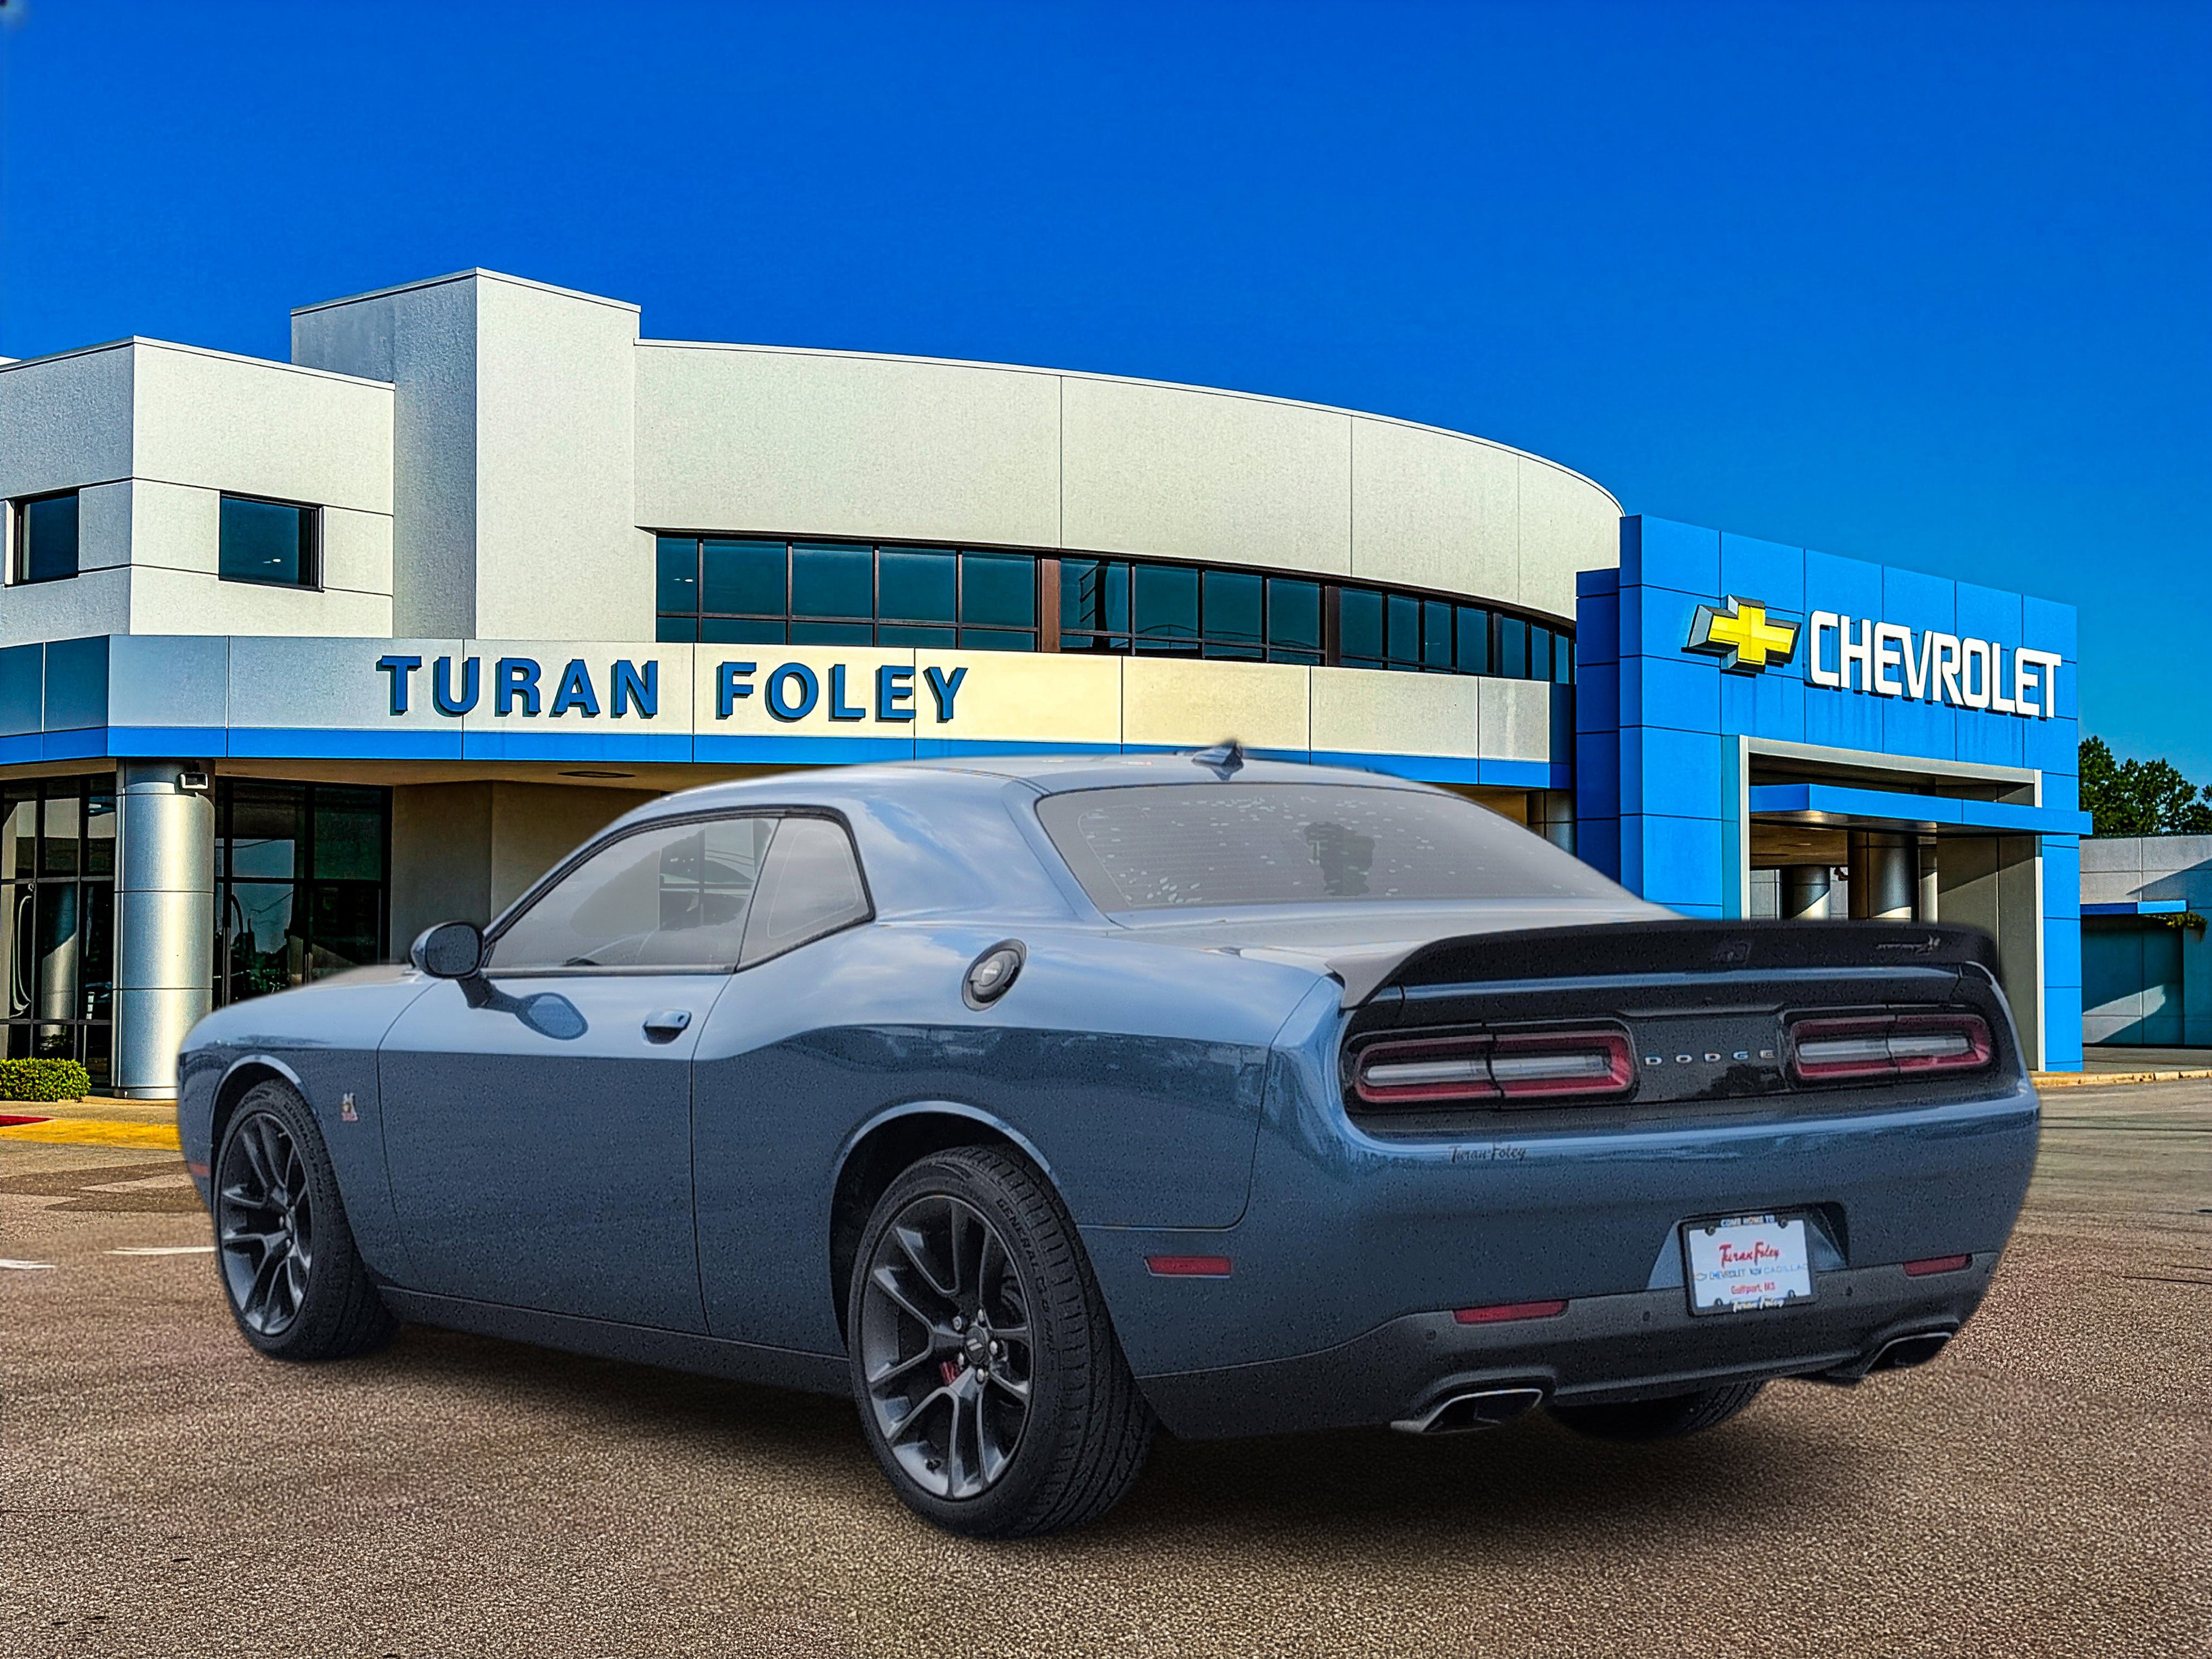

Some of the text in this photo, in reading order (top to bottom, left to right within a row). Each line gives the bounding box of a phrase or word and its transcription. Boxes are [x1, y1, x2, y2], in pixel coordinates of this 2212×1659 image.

[1807, 610, 2062, 719] CHEVROLET
[376, 654, 969, 724] TURAN FOLEY
[1644, 1049, 1775, 1065] DODGE
[1448, 1142, 1527, 1163] Turan Foley
[1719, 1241, 1779, 1268] Turan Foley
